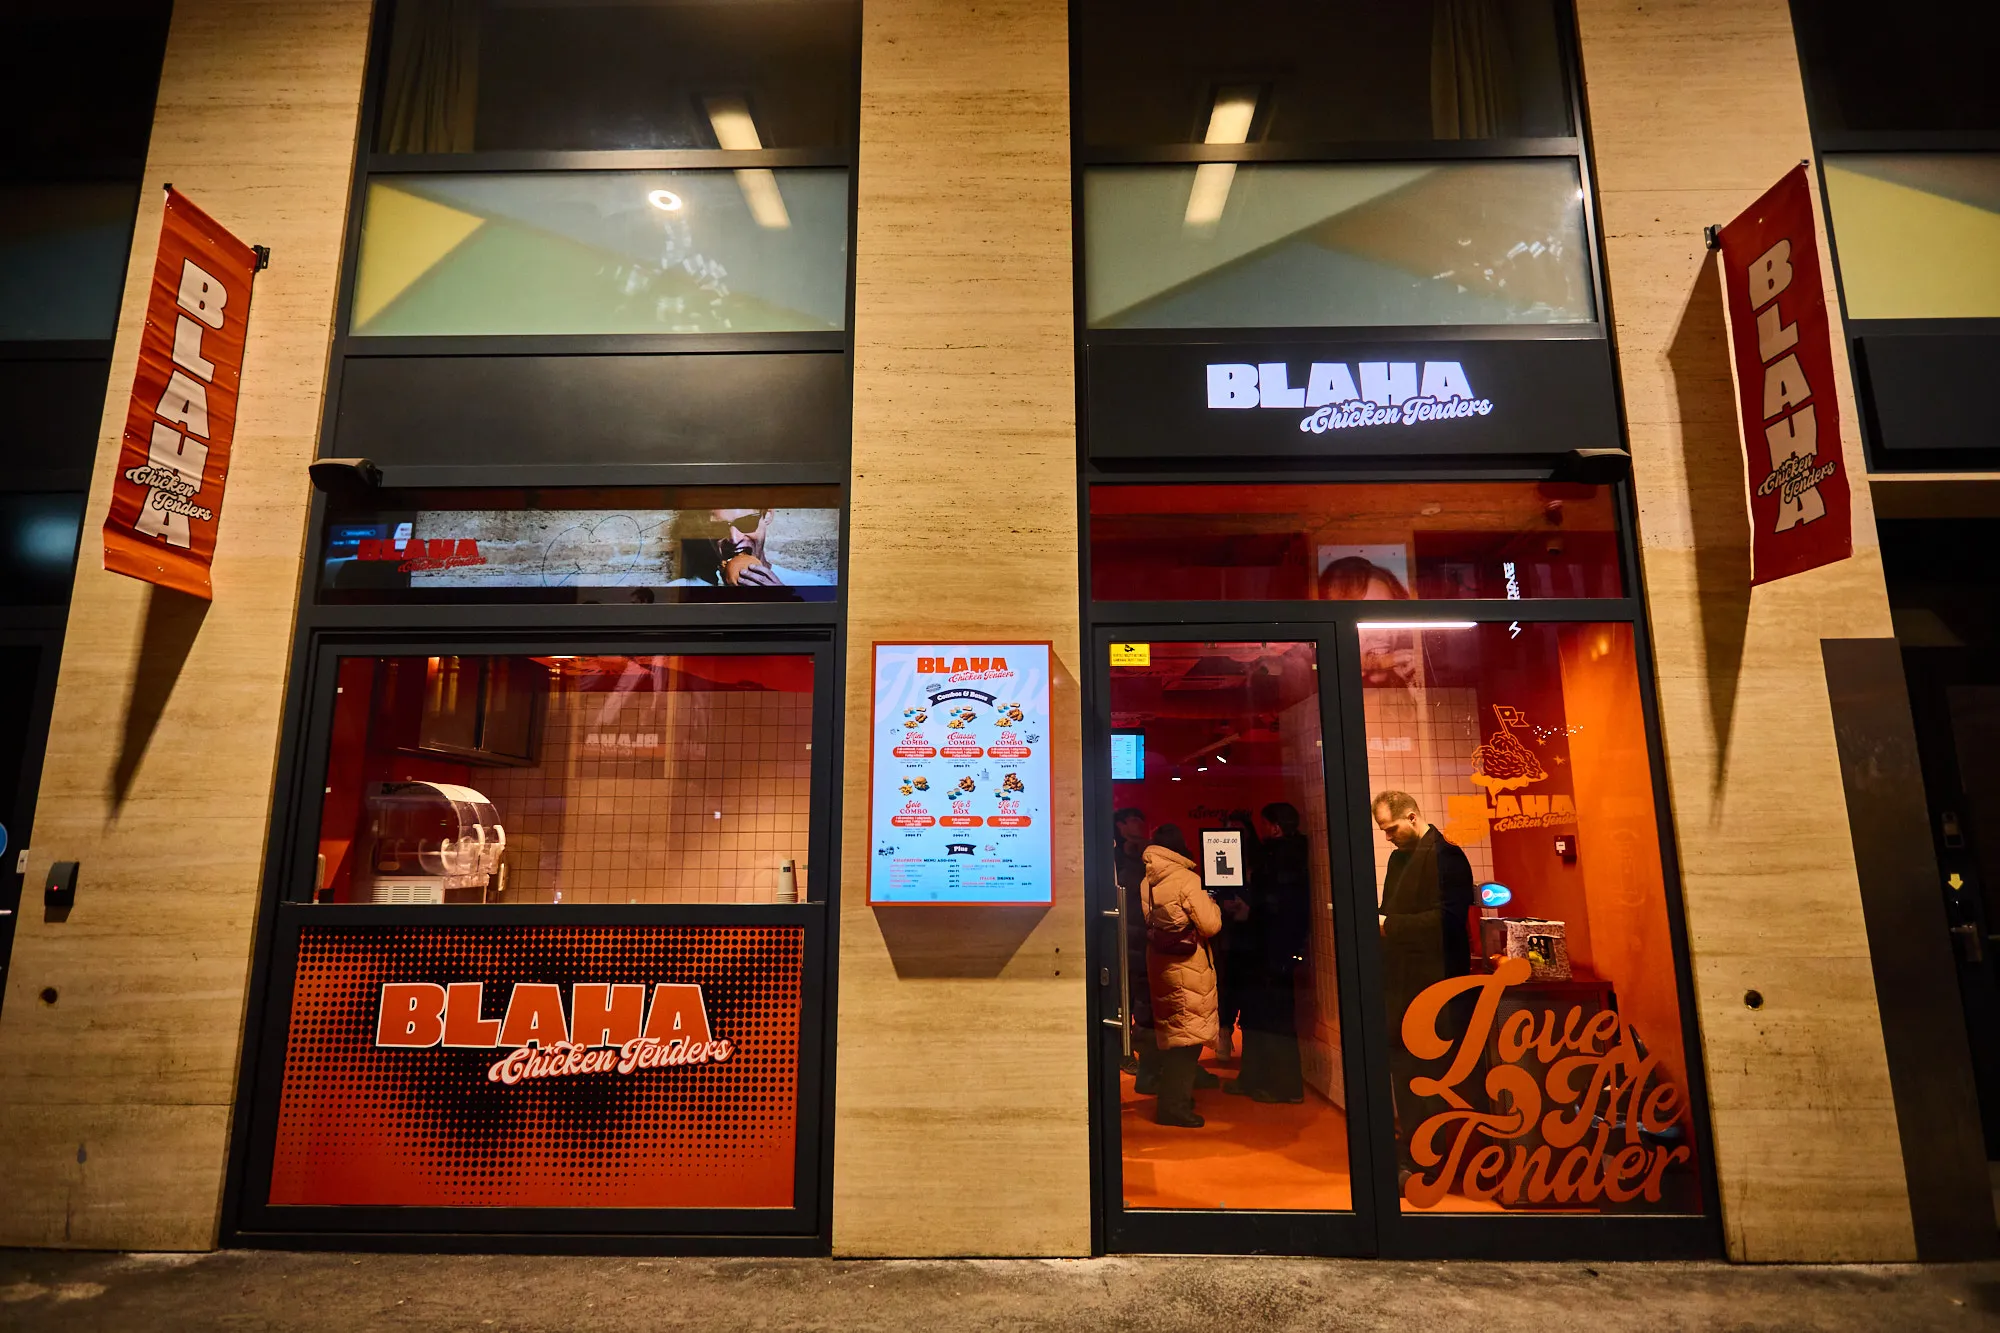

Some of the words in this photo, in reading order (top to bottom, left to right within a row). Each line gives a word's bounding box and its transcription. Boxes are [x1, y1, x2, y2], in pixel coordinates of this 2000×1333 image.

[134, 257, 228, 549] BLAHA
[1206, 361, 1475, 409] BLAHA
[1748, 239, 1827, 534] BLAHA
[1300, 400, 1402, 434] Chicken
[1402, 396, 1494, 426] Tenders
[125, 465, 195, 498] Chicken
[1757, 453, 1814, 497] Chicken
[1784, 461, 1836, 504] Tenders
[152, 490, 213, 521] Tenders
[357, 538, 479, 561] BLAHA
[917, 657, 1008, 674] BLAHA
[948, 672, 982, 683] Chicken
[983, 670, 1014, 681] Tenders
[937, 691, 962, 701] Combos
[1001, 731, 1017, 742] Big
[1494, 815, 1541, 832] Chicken
[375, 982, 714, 1049] BLAHA
[1401, 957, 1620, 1109] Love
[487, 1040, 618, 1085] Chicken
[618, 1035, 736, 1073] Tenders
[1542, 1045, 1687, 1148] Me
[1404, 1108, 1690, 1209] Tender
